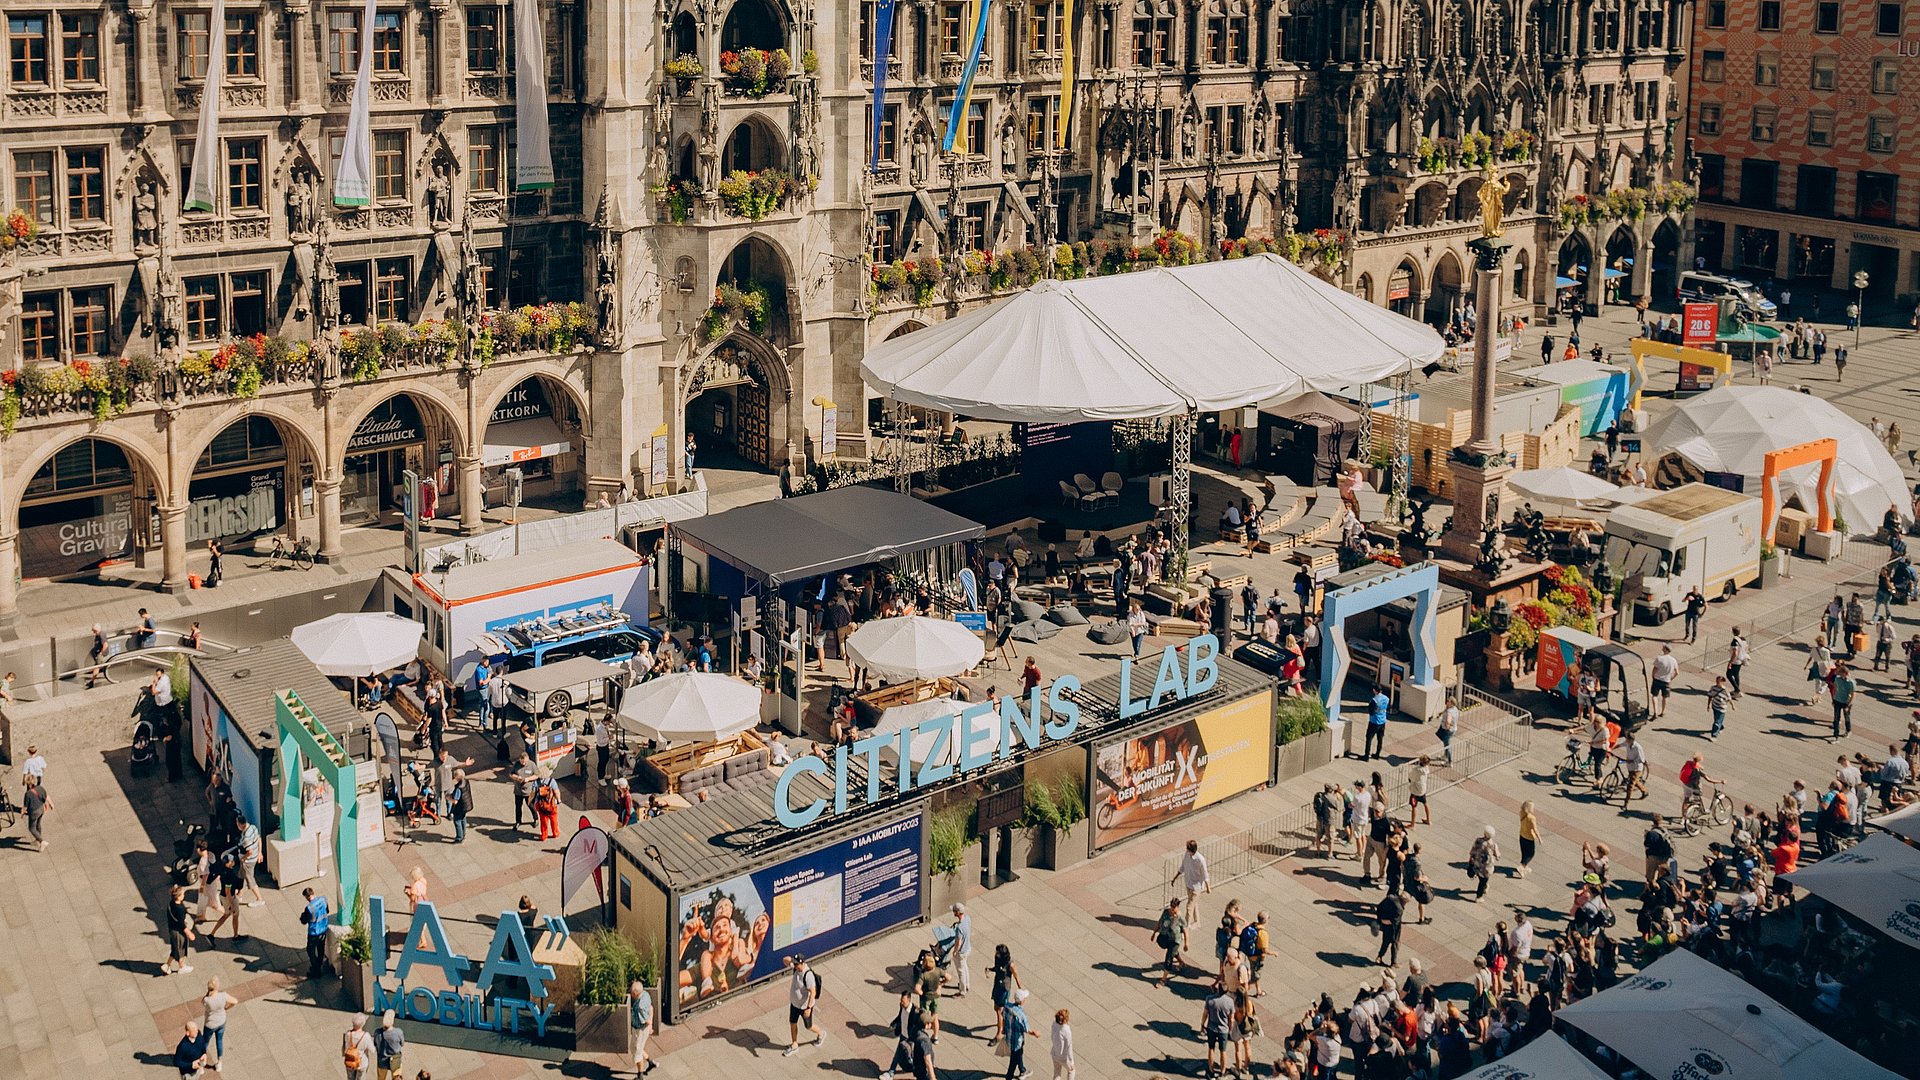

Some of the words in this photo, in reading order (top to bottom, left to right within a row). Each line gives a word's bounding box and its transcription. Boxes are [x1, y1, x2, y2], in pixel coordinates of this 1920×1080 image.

[1690, 319, 1702, 331] 20
[355, 413, 403, 435] Linda
[348, 428, 416, 448] ARSCHMUCK
[250, 473, 270, 482] Grand
[250, 479, 276, 488] Opening
[404, 476, 411, 495] S
[184, 487, 276, 544] BERGSON
[404, 496, 411, 516] U
[59, 513, 132, 541] Cultural
[60, 532, 128, 556] Gravity
[773, 674, 1081, 830] CITIZENS
[1119, 633, 1220, 720] LAB
[1131, 760, 1176, 785] MOBILITÄT
[1118, 786, 1136, 802] DER
[1136, 772, 1176, 796] ZUKUNFT
[858, 836, 872, 848] IAA
[872, 824, 902, 842] MOBILITY
[901, 817, 919, 831] 2023
[373, 980, 556, 1038] MOBILITY
